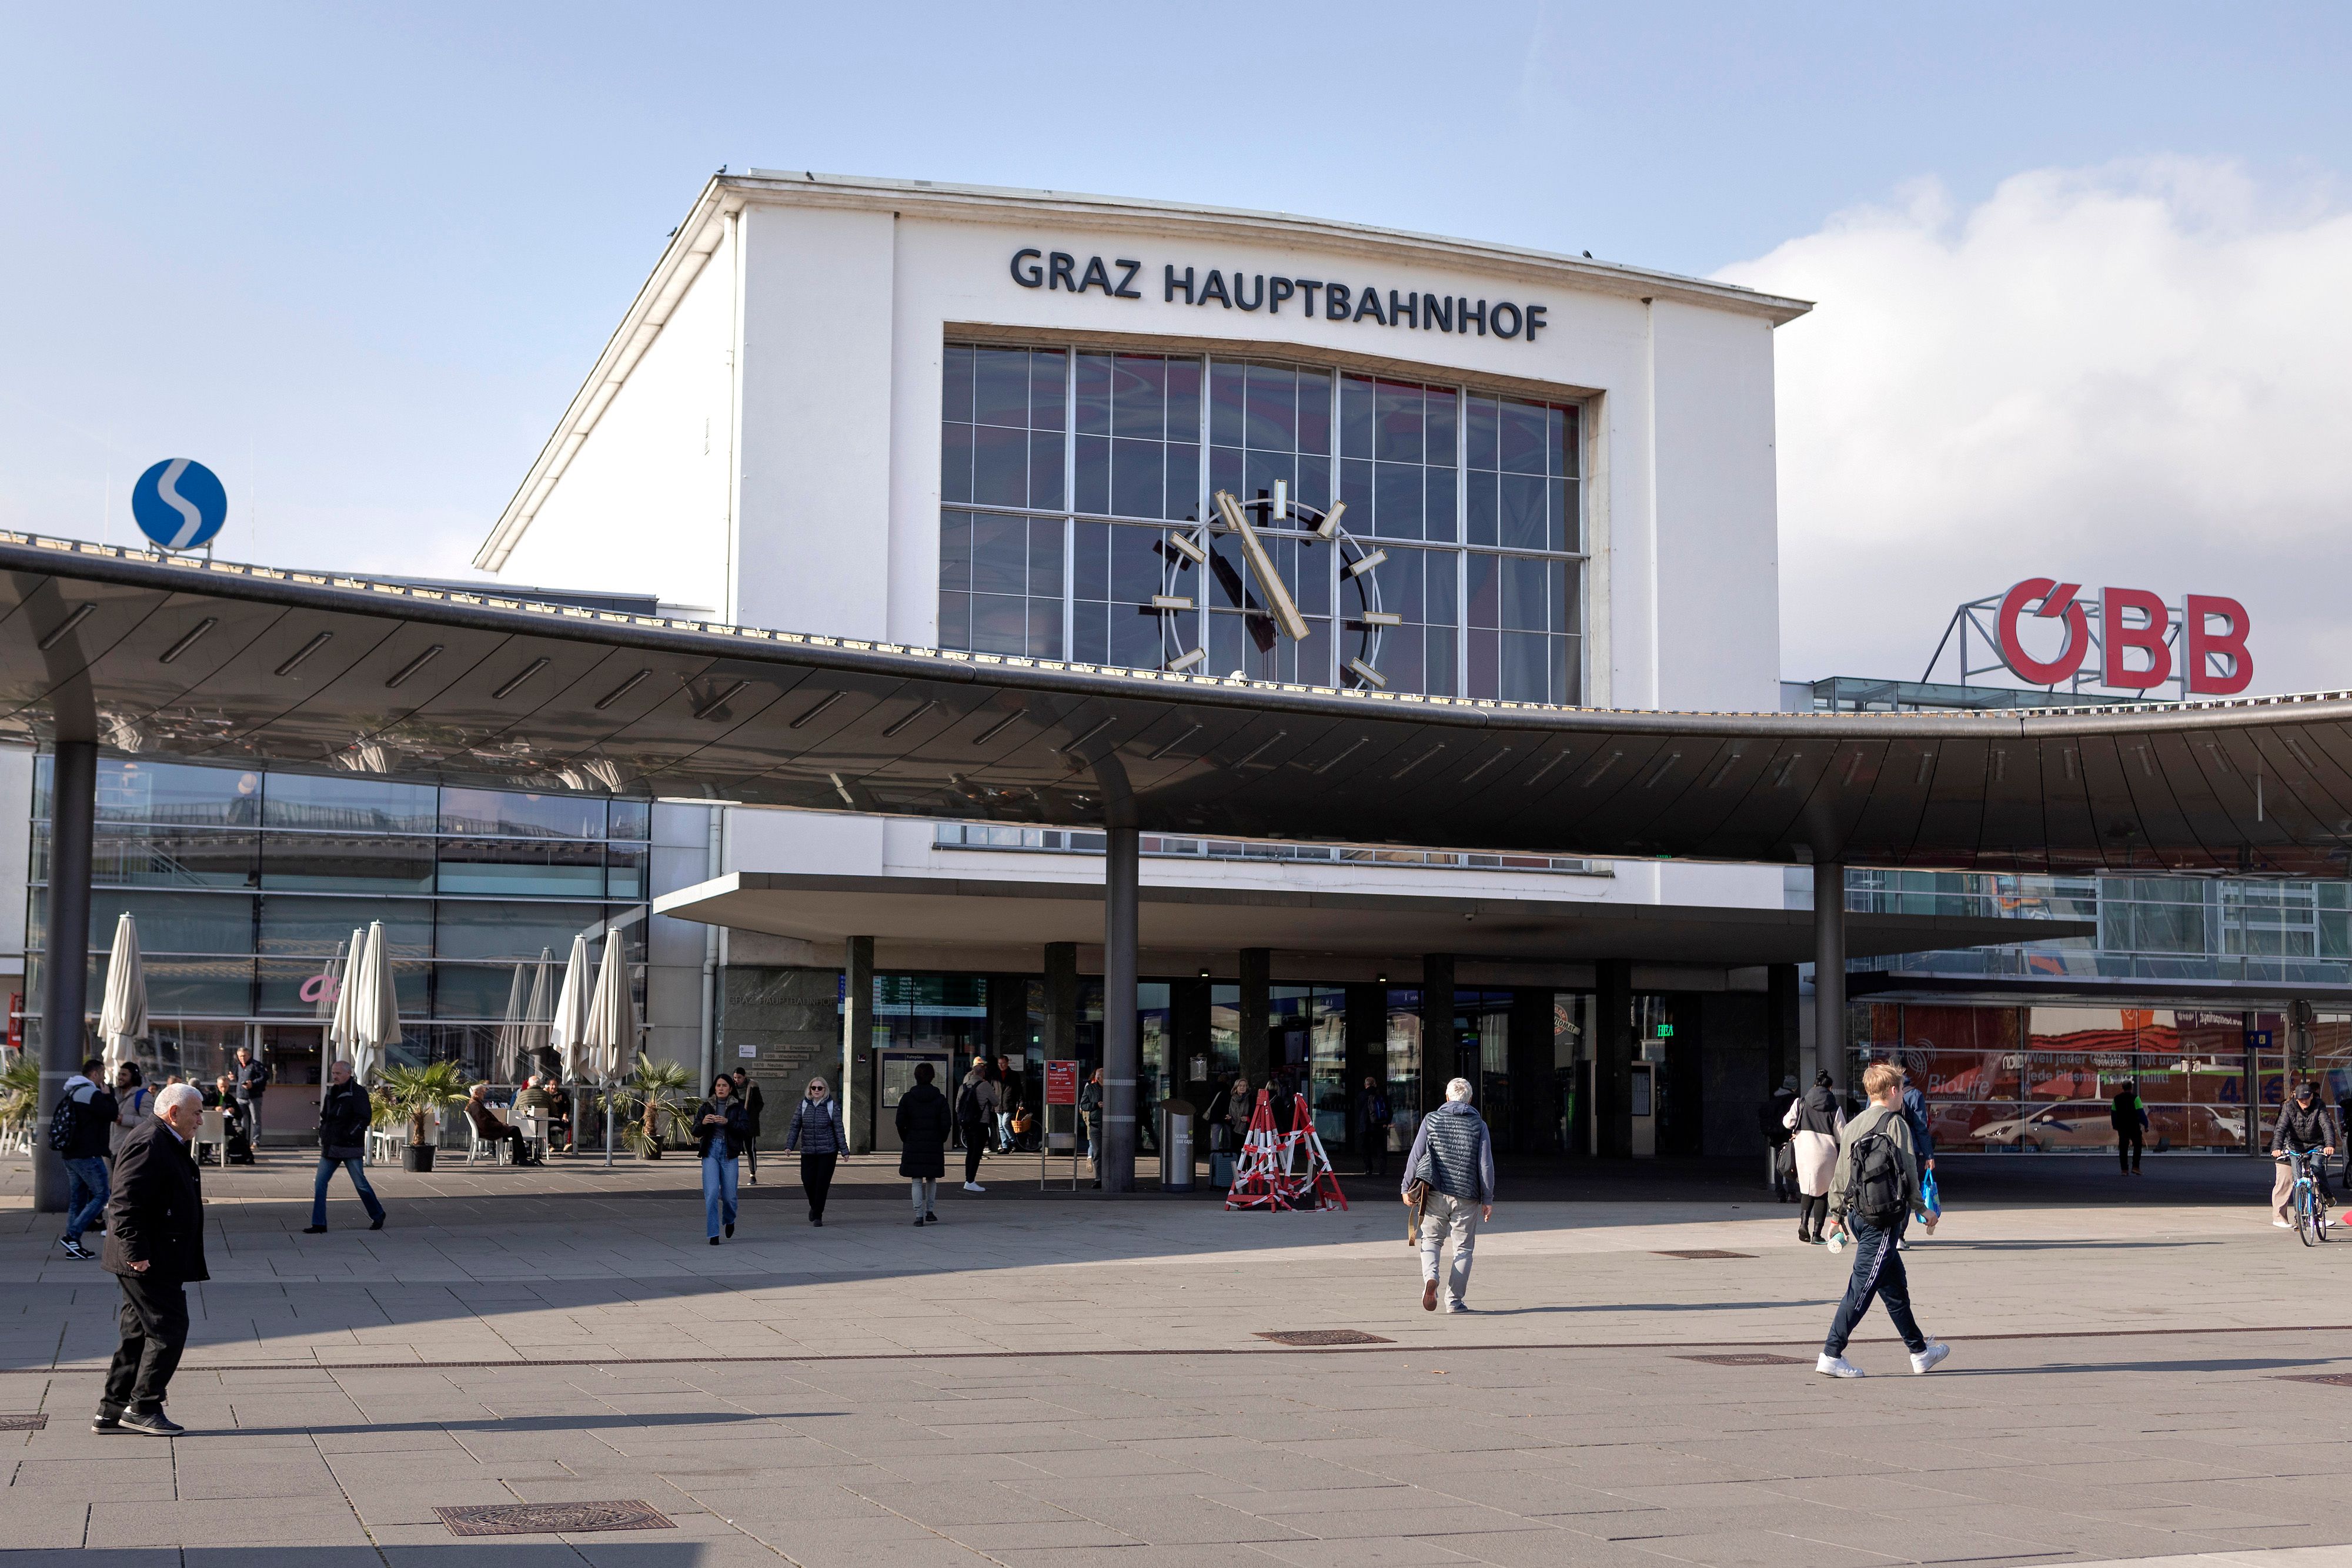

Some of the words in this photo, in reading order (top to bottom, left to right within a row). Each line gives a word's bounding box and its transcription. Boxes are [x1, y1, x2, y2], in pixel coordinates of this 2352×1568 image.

[1010, 248, 1142, 298] GRAZ
[1164, 263, 1549, 341] HAUPTBAHNHOF
[1993, 577, 2253, 695] ÖBB
[759, 997, 834, 1006] HAUPTBAHNHOF
[1555, 1018, 1575, 1032] TOMAT
[2026, 1053, 2053, 1064] Weil
[2055, 1053, 2087, 1066] jeder
[2159, 1053, 2181, 1065] und
[2026, 1069, 2053, 1083] jede
[1927, 1073, 1990, 1101] BioLife
